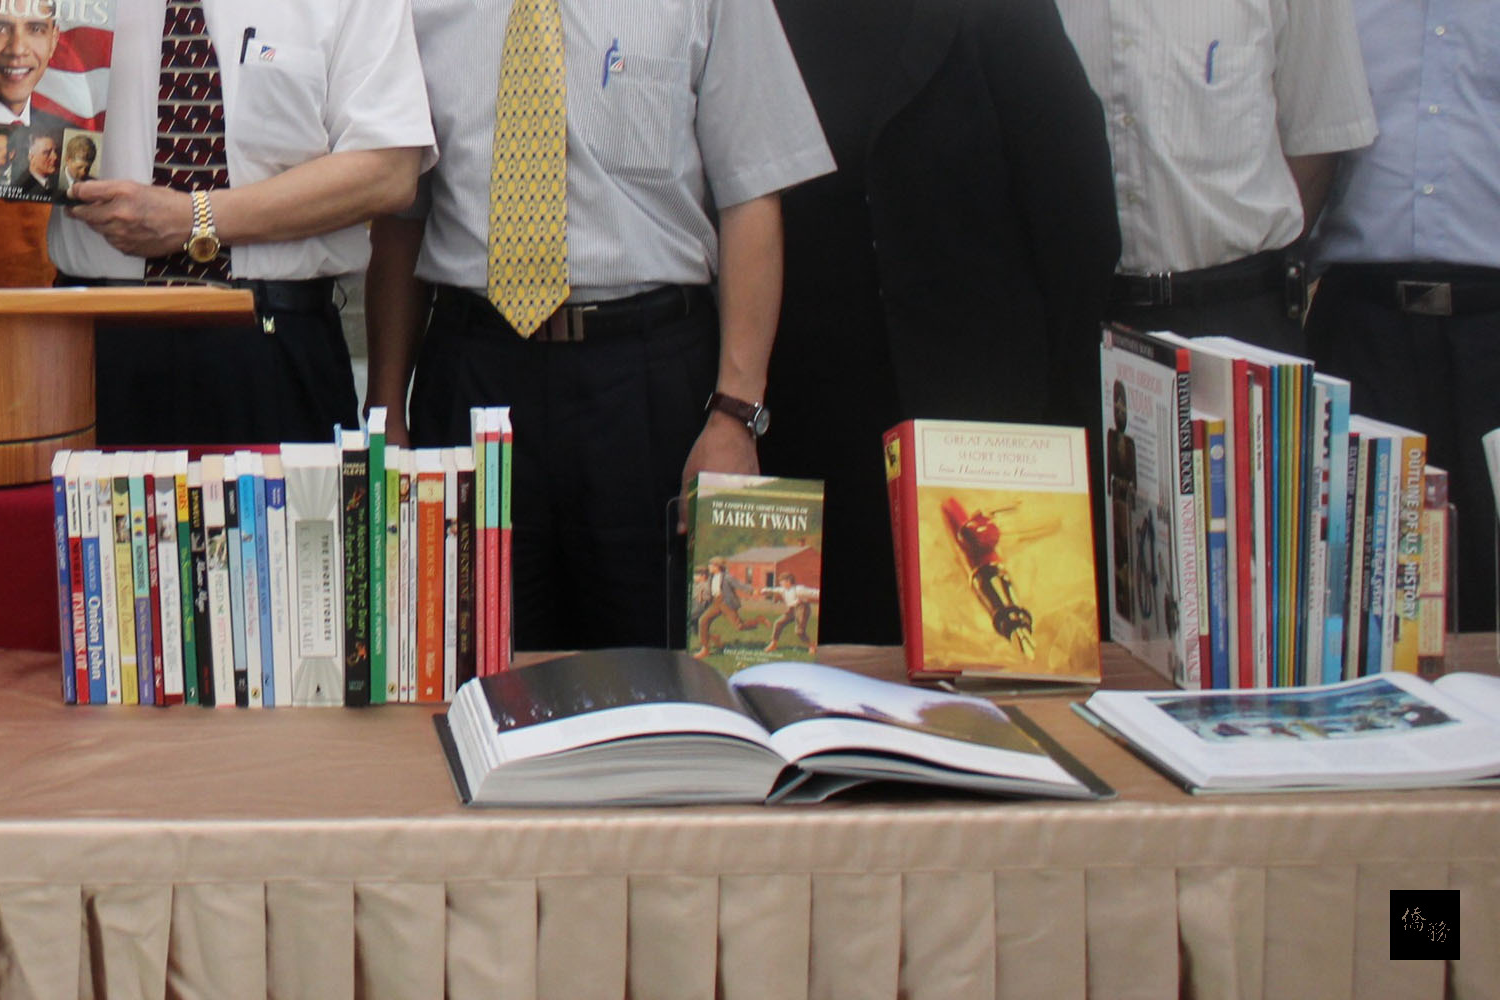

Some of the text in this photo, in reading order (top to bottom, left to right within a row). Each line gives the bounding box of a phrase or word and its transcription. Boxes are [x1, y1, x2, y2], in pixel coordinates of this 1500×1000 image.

[943, 433, 1051, 450] GREAT AMERICAN
[1178, 373, 1192, 494] EYEWITNESS BOOKS
[958, 451, 1038, 465] SHORT STORIES
[1406, 448, 1422, 507] OUTLINE
[711, 510, 808, 531] MARK TWAIN
[724, 502, 754, 511] COMPLETE
[1180, 501, 1195, 547] NORTH
[1406, 511, 1420, 529] OF
[426, 507, 436, 544] LITTLE
[345, 534, 356, 592] Part-Time
[426, 545, 436, 577] HOUSE
[322, 536, 332, 641] THE SHORT STORIES
[358, 582, 367, 607] True
[1182, 550, 1197, 617] AMERICAN
[1403, 562, 1418, 620] HISTORY
[346, 594, 356, 631] Indian
[356, 609, 367, 639] Diary
[88, 596, 104, 680] Onion John
